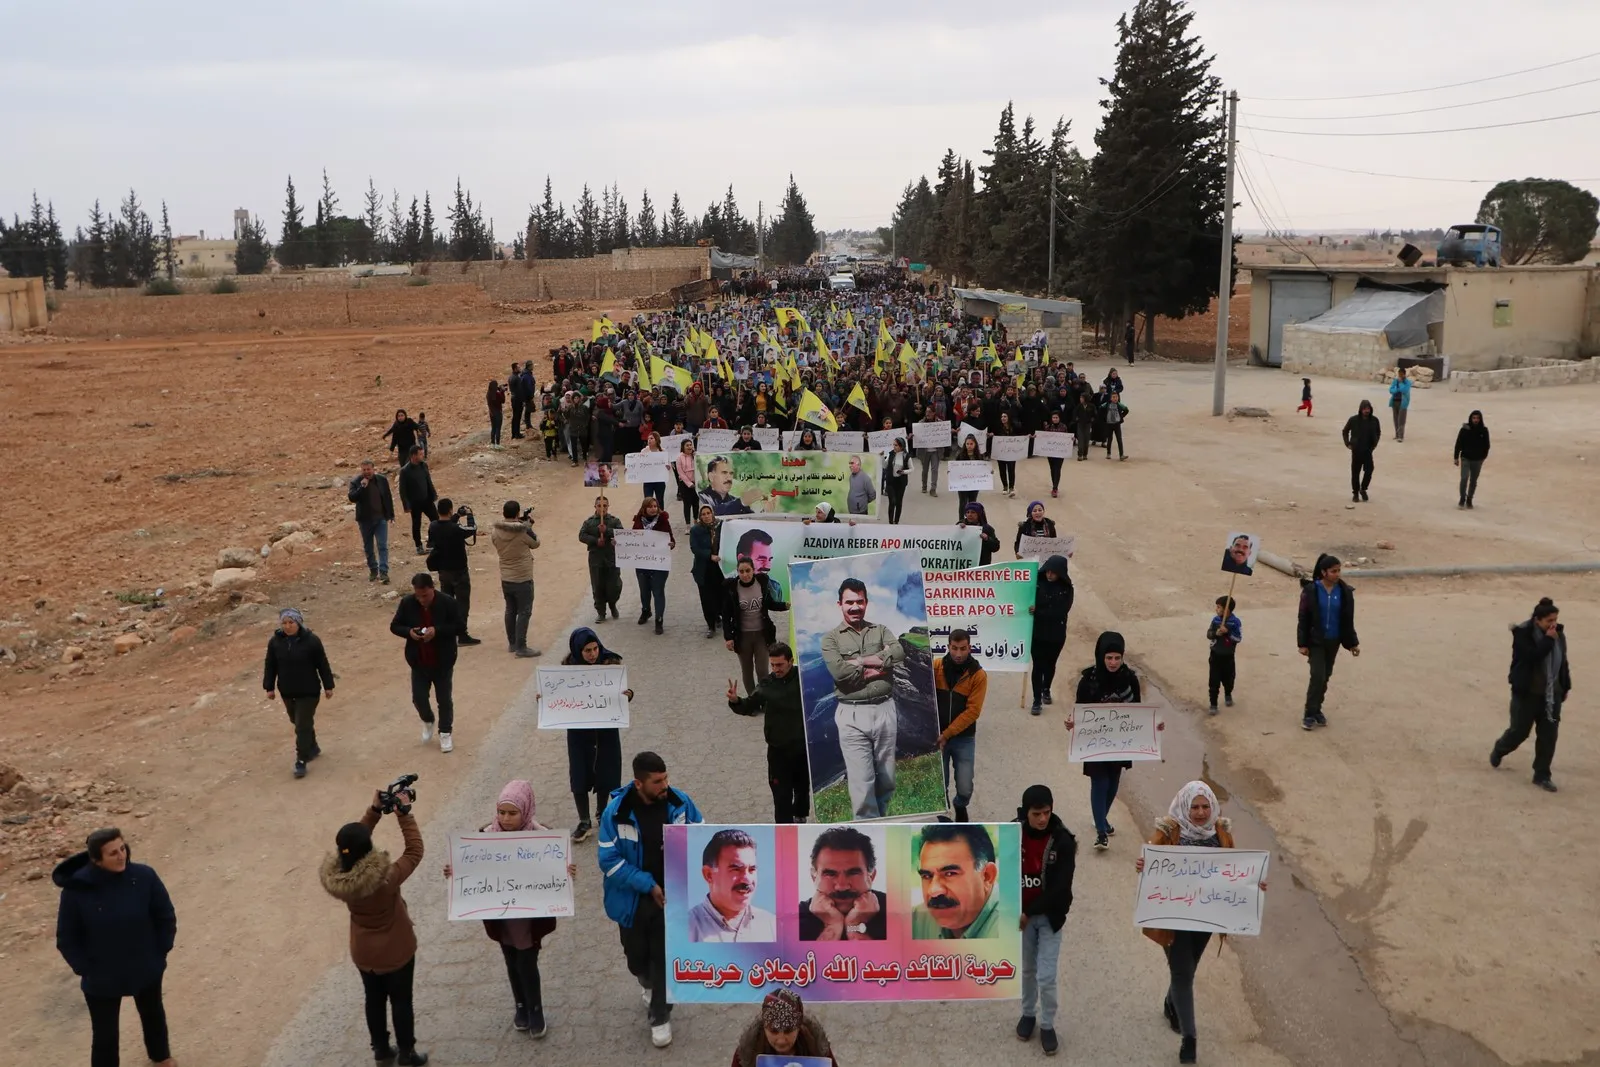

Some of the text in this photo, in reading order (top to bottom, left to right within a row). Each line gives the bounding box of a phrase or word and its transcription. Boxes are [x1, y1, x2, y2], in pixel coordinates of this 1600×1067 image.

[806, 473, 820, 481] نظام
[801, 487, 820, 496] القائد
[822, 488, 832, 496] مع
[847, 538, 879, 549] REBER
[881, 538, 900, 549] APO
[921, 557, 972, 570] OKRATİKE
[1014, 570, 1030, 581] RE
[927, 603, 1014, 616] RÊBER APO YE
[985, 639, 1008, 657] أوان
[544, 672, 613, 694] حان وقت حرية
[582, 694, 611, 710] القائد
[1082, 709, 1130, 723] Dem Dema
[495, 851, 512, 862] ser
[1172, 857, 1205, 878] القائد
[1200, 860, 1219, 878] على
[1221, 863, 1255, 881] العزلة
[455, 875, 493, 896] Tecrîda
[1147, 884, 1248, 907] عزلة على الإنسانية
[673, 951, 1017, 988] حرية القائد عبد الله أوجلان حريتنا
